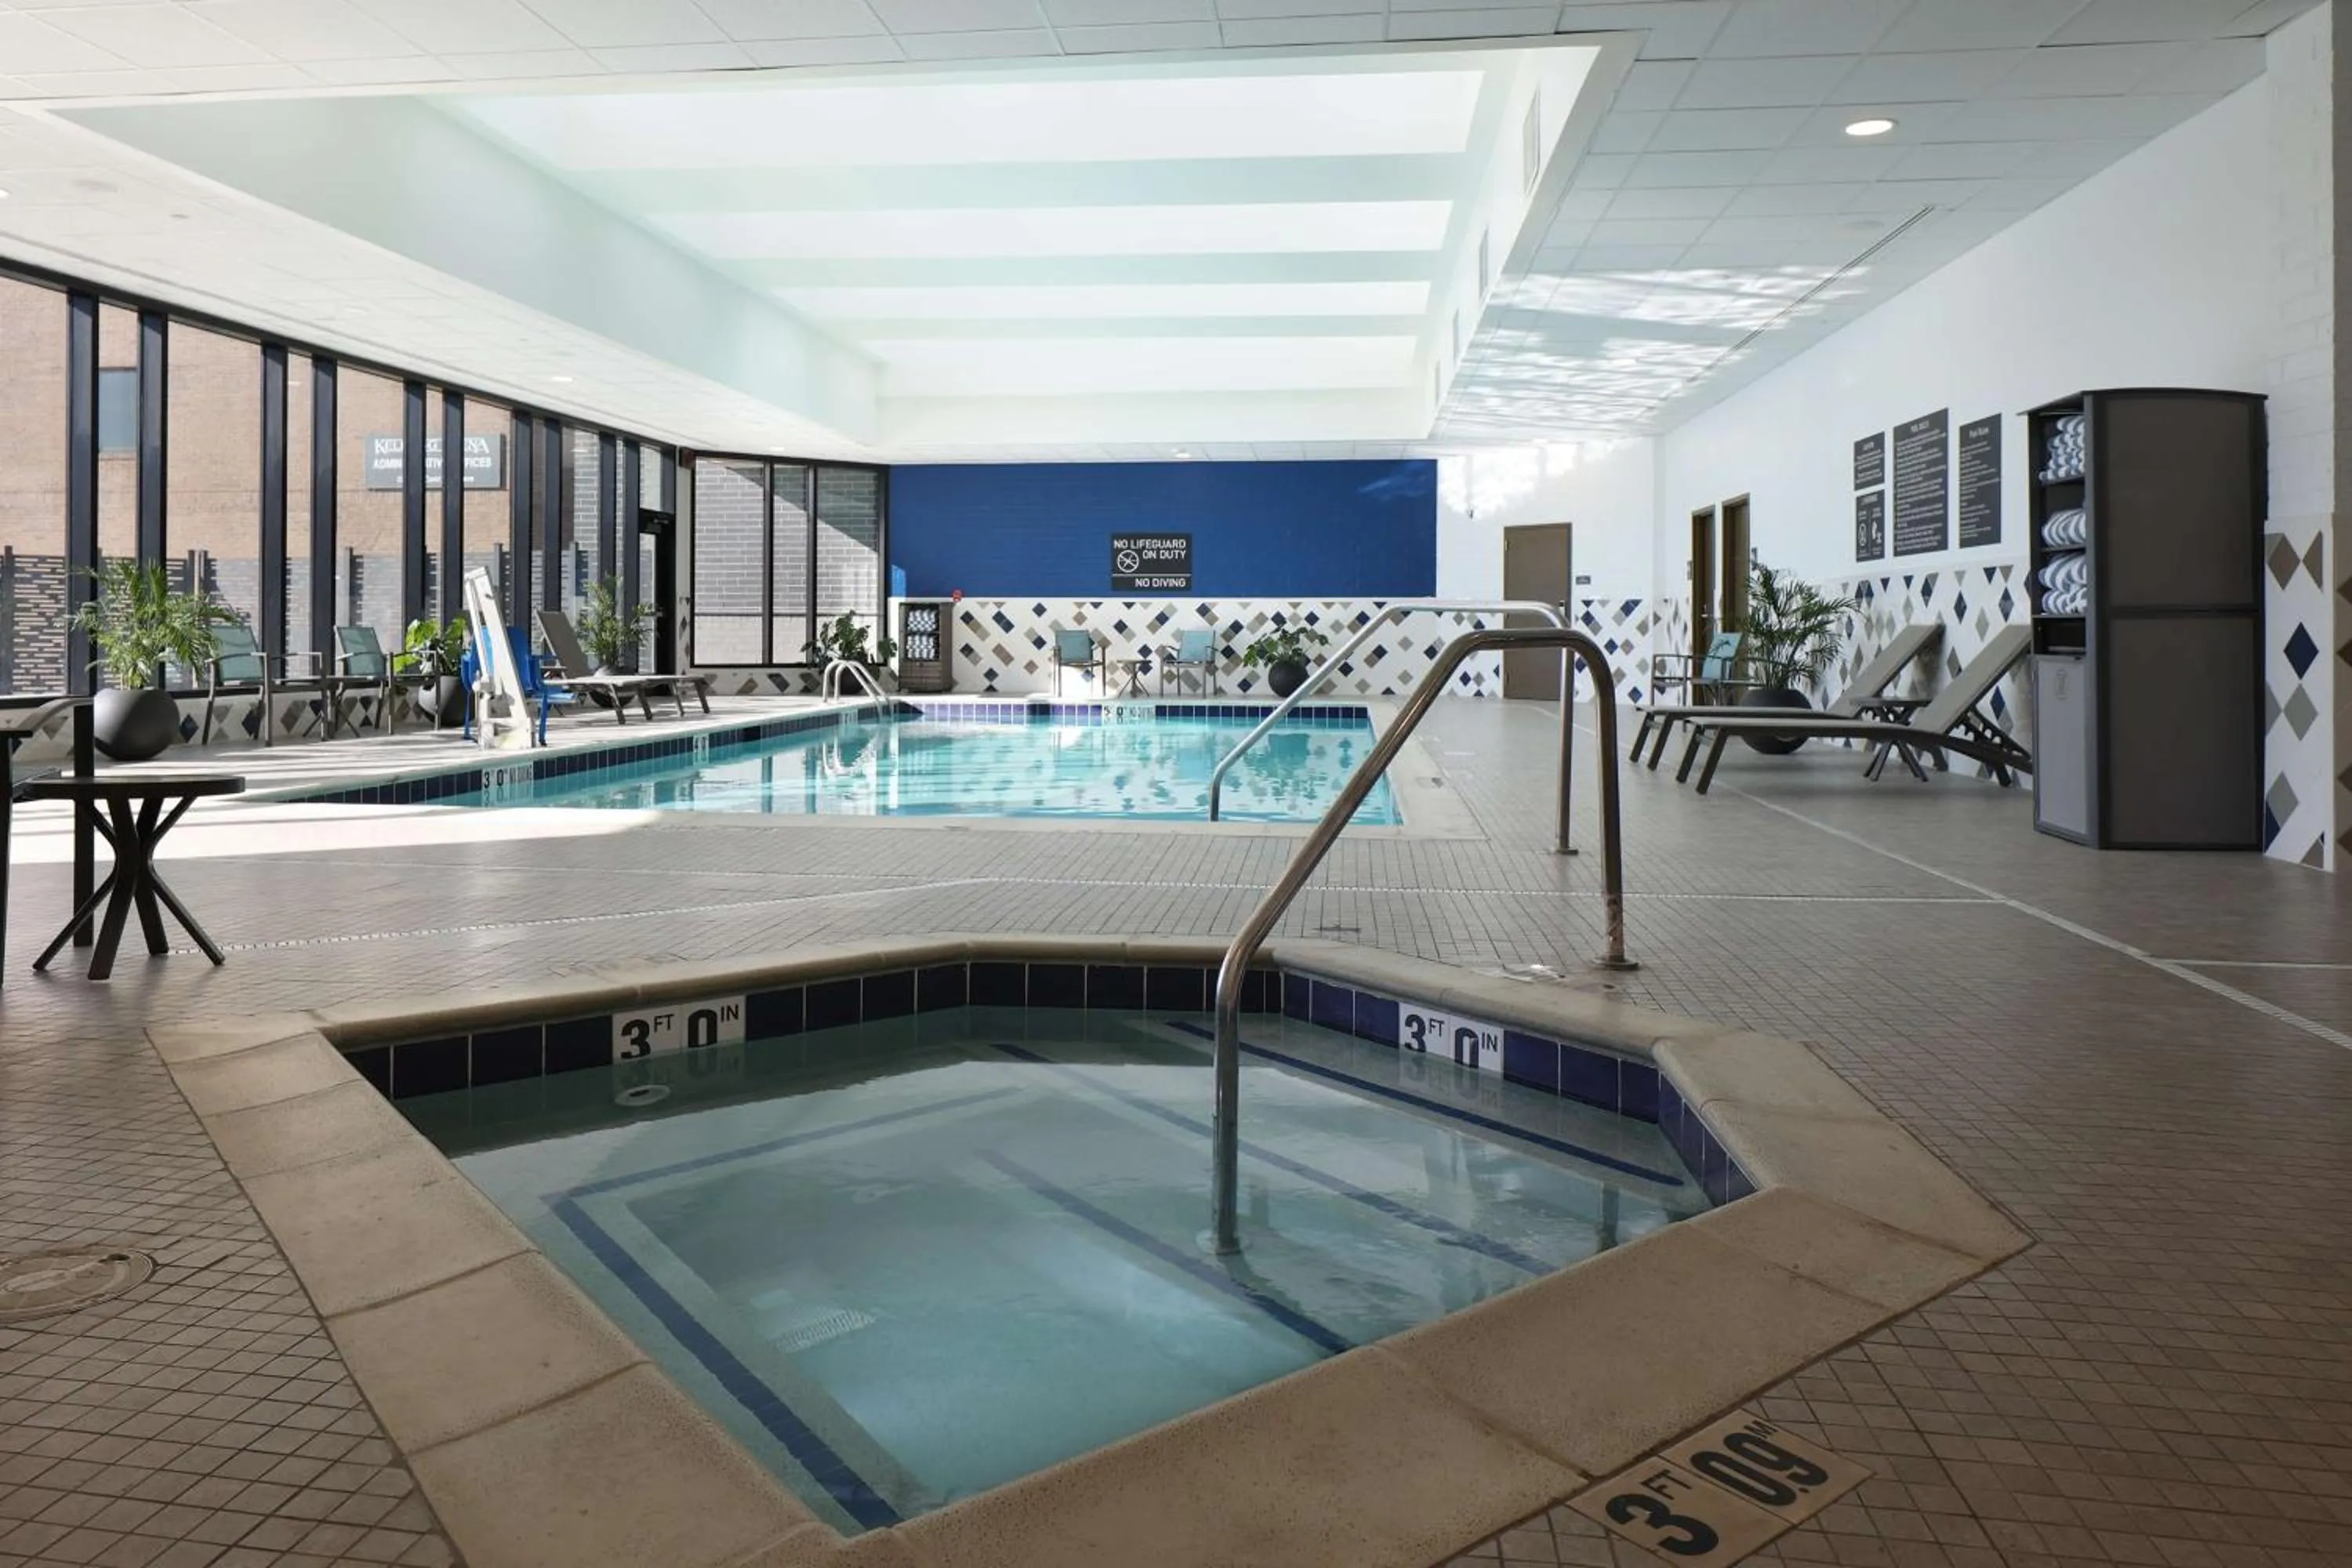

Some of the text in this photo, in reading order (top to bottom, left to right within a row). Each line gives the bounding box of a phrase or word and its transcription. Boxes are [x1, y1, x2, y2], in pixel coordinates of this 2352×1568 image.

[1113, 539, 1186, 550] NO LIFEGUARD
[1142, 550, 1186, 559] ON DUTY
[1134, 578, 1186, 587] NO DIVING
